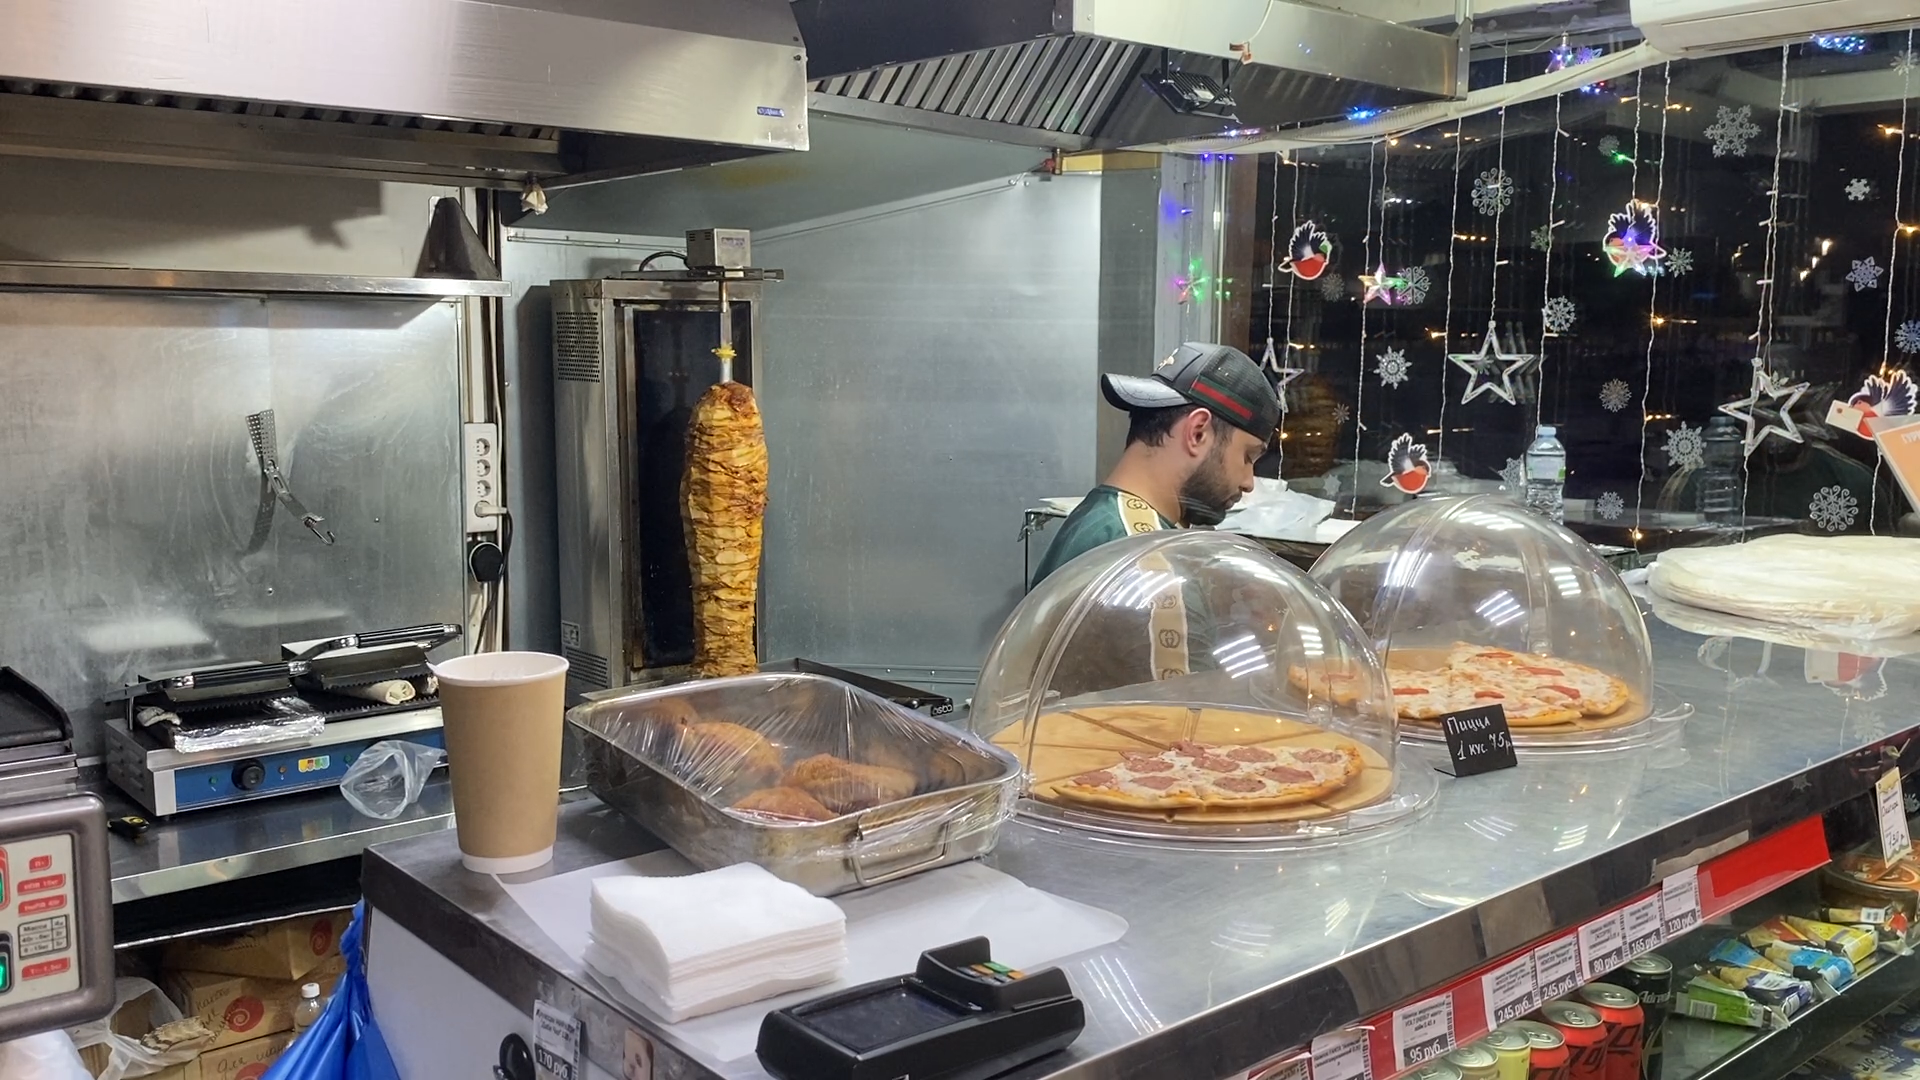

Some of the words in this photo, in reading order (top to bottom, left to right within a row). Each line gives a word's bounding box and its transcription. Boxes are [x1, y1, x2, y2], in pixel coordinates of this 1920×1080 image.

[1457, 740, 1466, 760] 1
[1668, 918, 1681, 932] 120
[1631, 941, 1644, 954] 165
[1593, 959, 1603, 973] 80
[1542, 984, 1558, 1000] 245
[1497, 1007, 1514, 1023] 245
[1410, 1046, 1422, 1063] 95
[1424, 1039, 1443, 1060] руб.
[538, 1049, 553, 1070] 170
